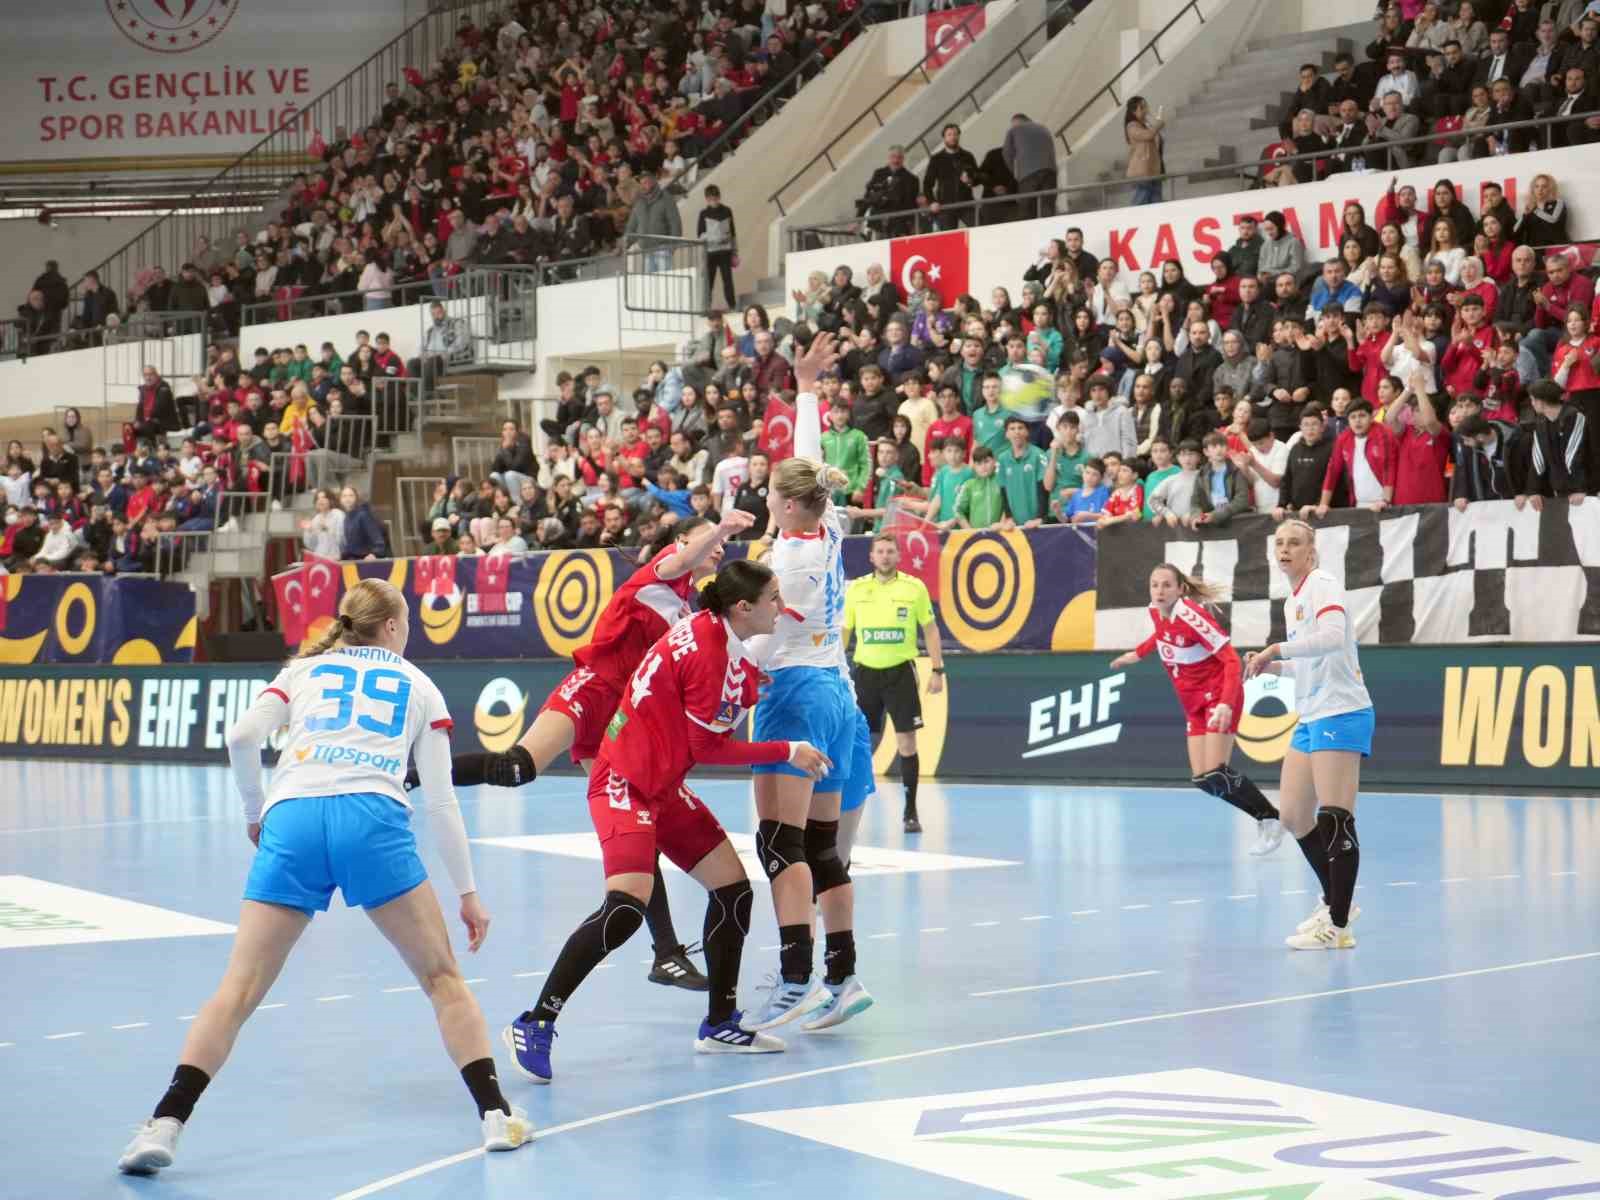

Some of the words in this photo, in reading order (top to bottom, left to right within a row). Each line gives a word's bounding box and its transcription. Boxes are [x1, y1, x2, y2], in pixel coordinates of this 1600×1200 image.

[38, 76, 97, 102] T.C.
[108, 66, 256, 104] GENÇLİK
[267, 68, 310, 94] VE
[39, 114, 125, 142] SPOR
[135, 103, 311, 139] BAKANLIĞI
[873, 630, 905, 641] DEKRA
[0, 678, 133, 747] WOMEN'S
[138, 679, 200, 748] EHF
[304, 663, 411, 738] 39
[1027, 672, 1127, 745] EHF
